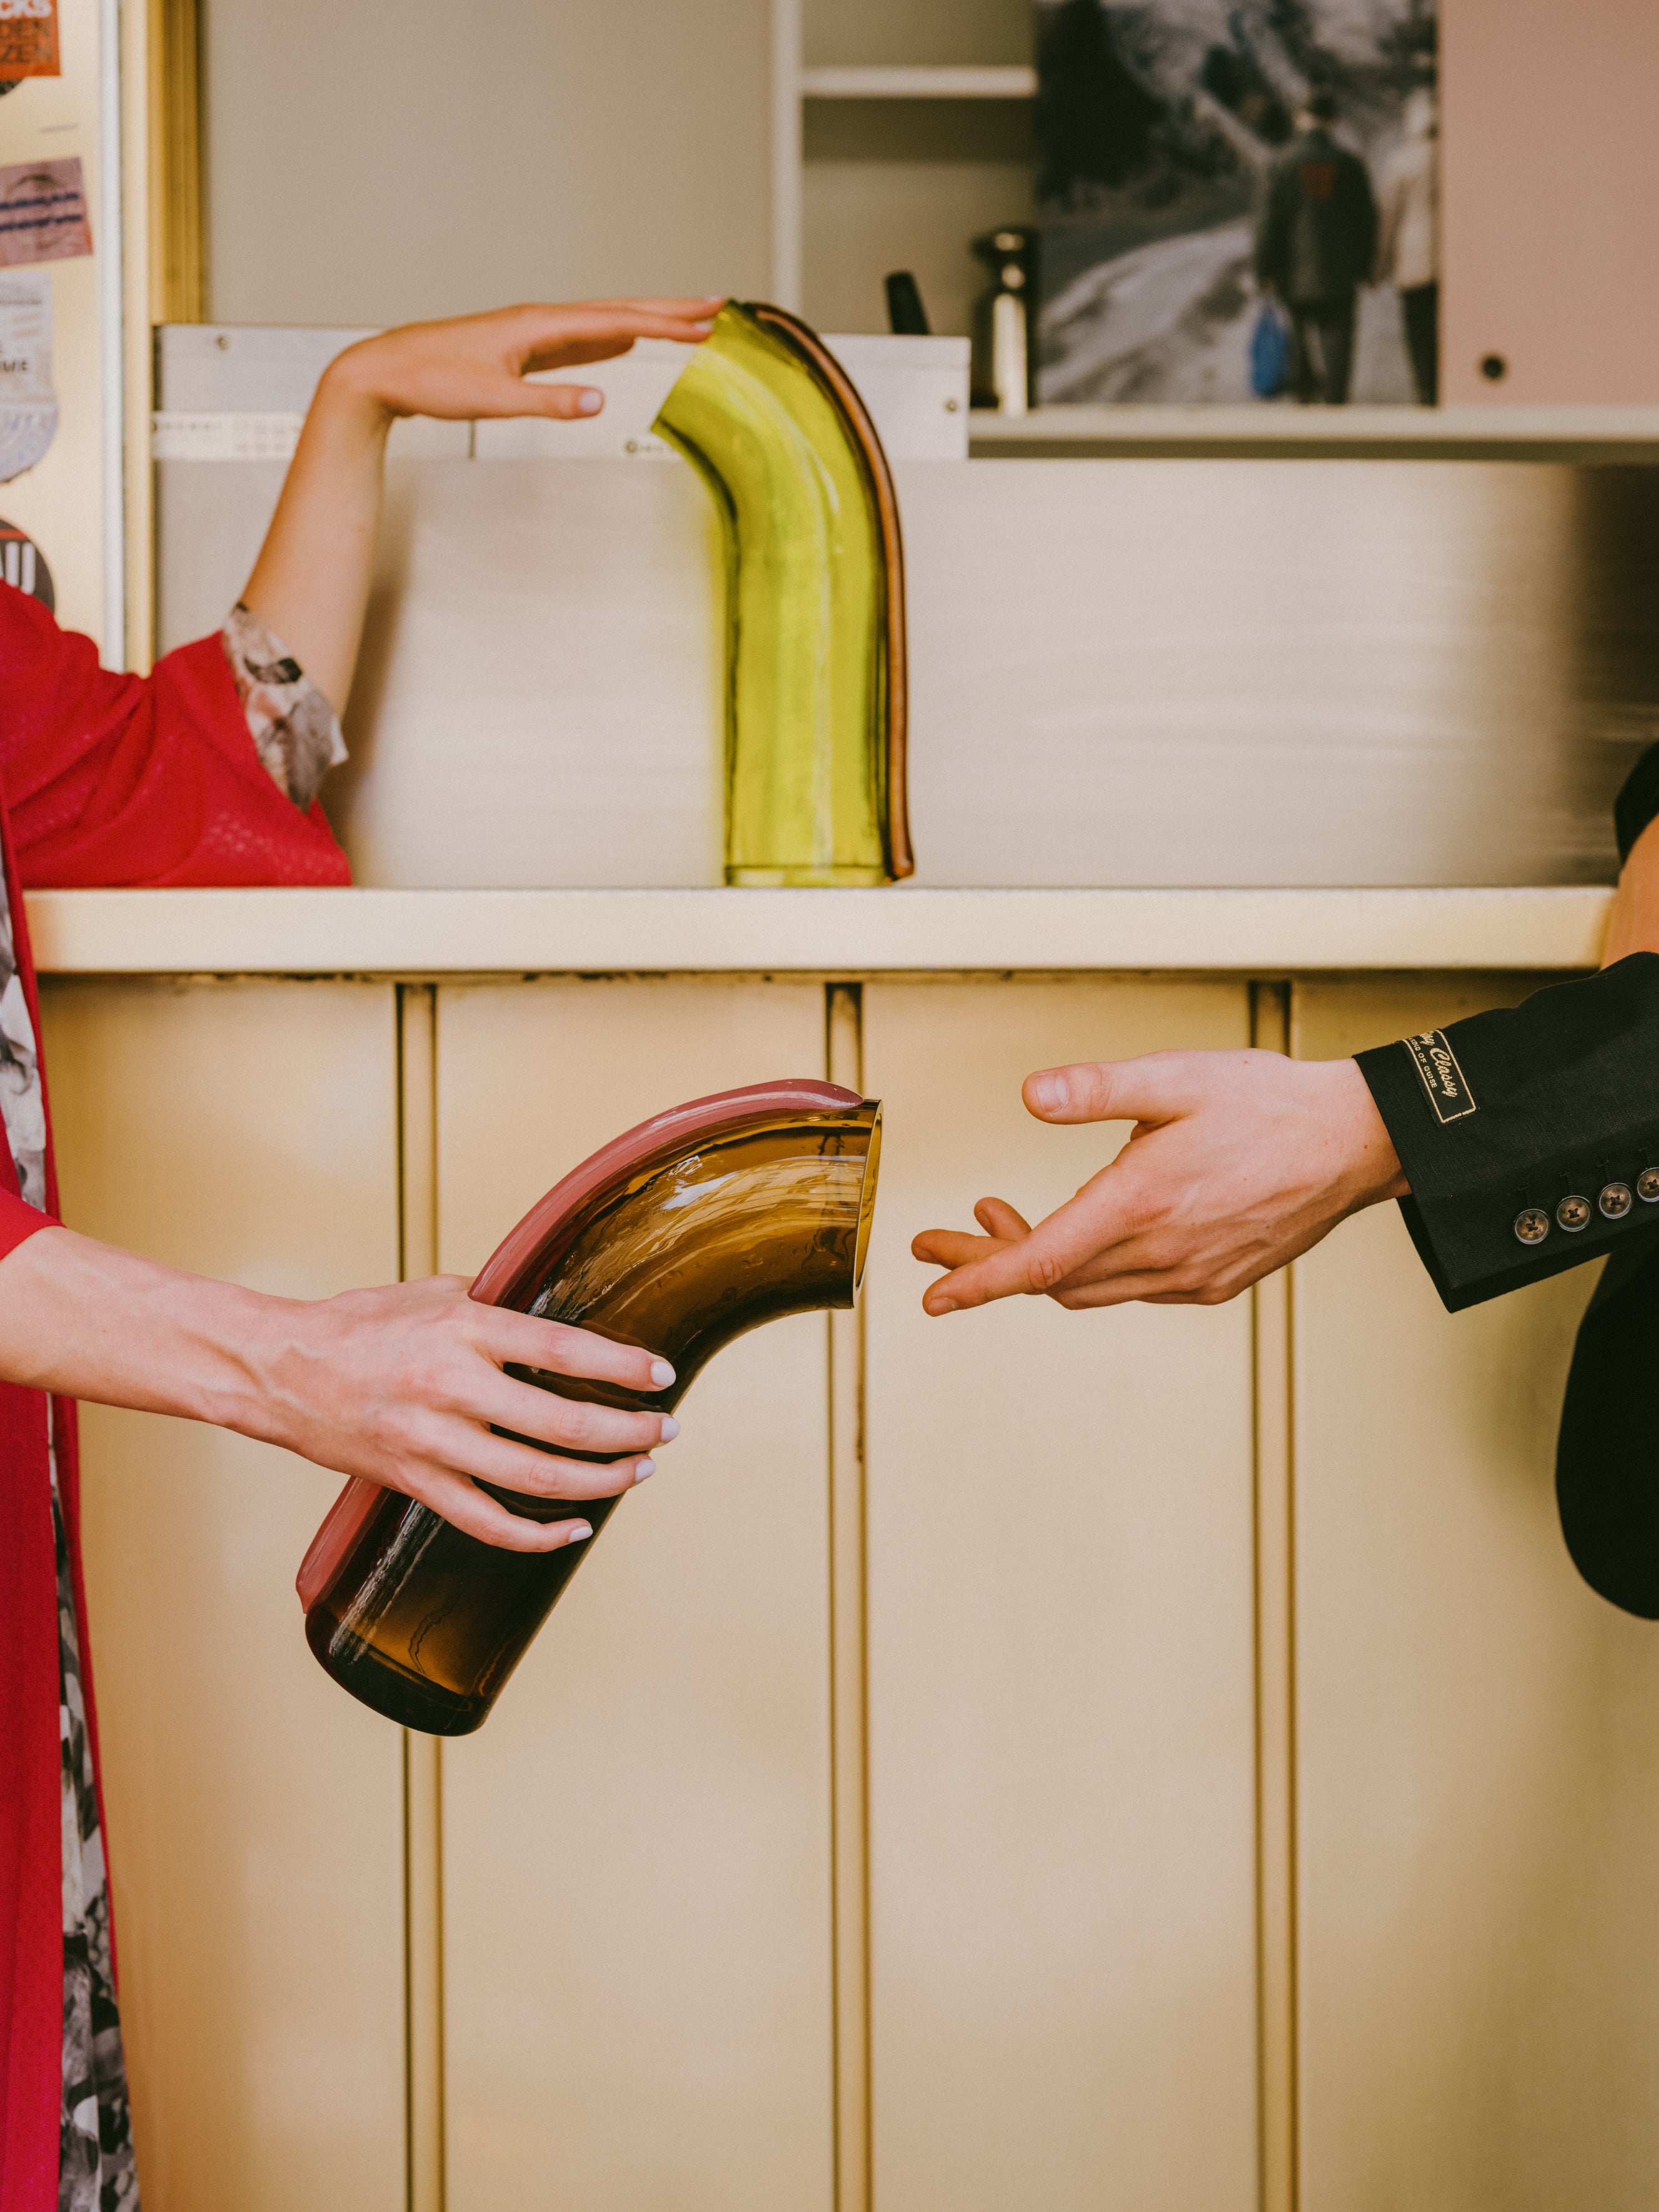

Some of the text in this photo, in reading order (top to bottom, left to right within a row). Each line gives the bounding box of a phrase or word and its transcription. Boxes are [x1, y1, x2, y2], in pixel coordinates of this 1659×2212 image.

[1418, 1053, 1427, 1063] OF
[1424, 1065, 1437, 1088] GUISE
[1429, 1047, 1458, 1098] Classy
